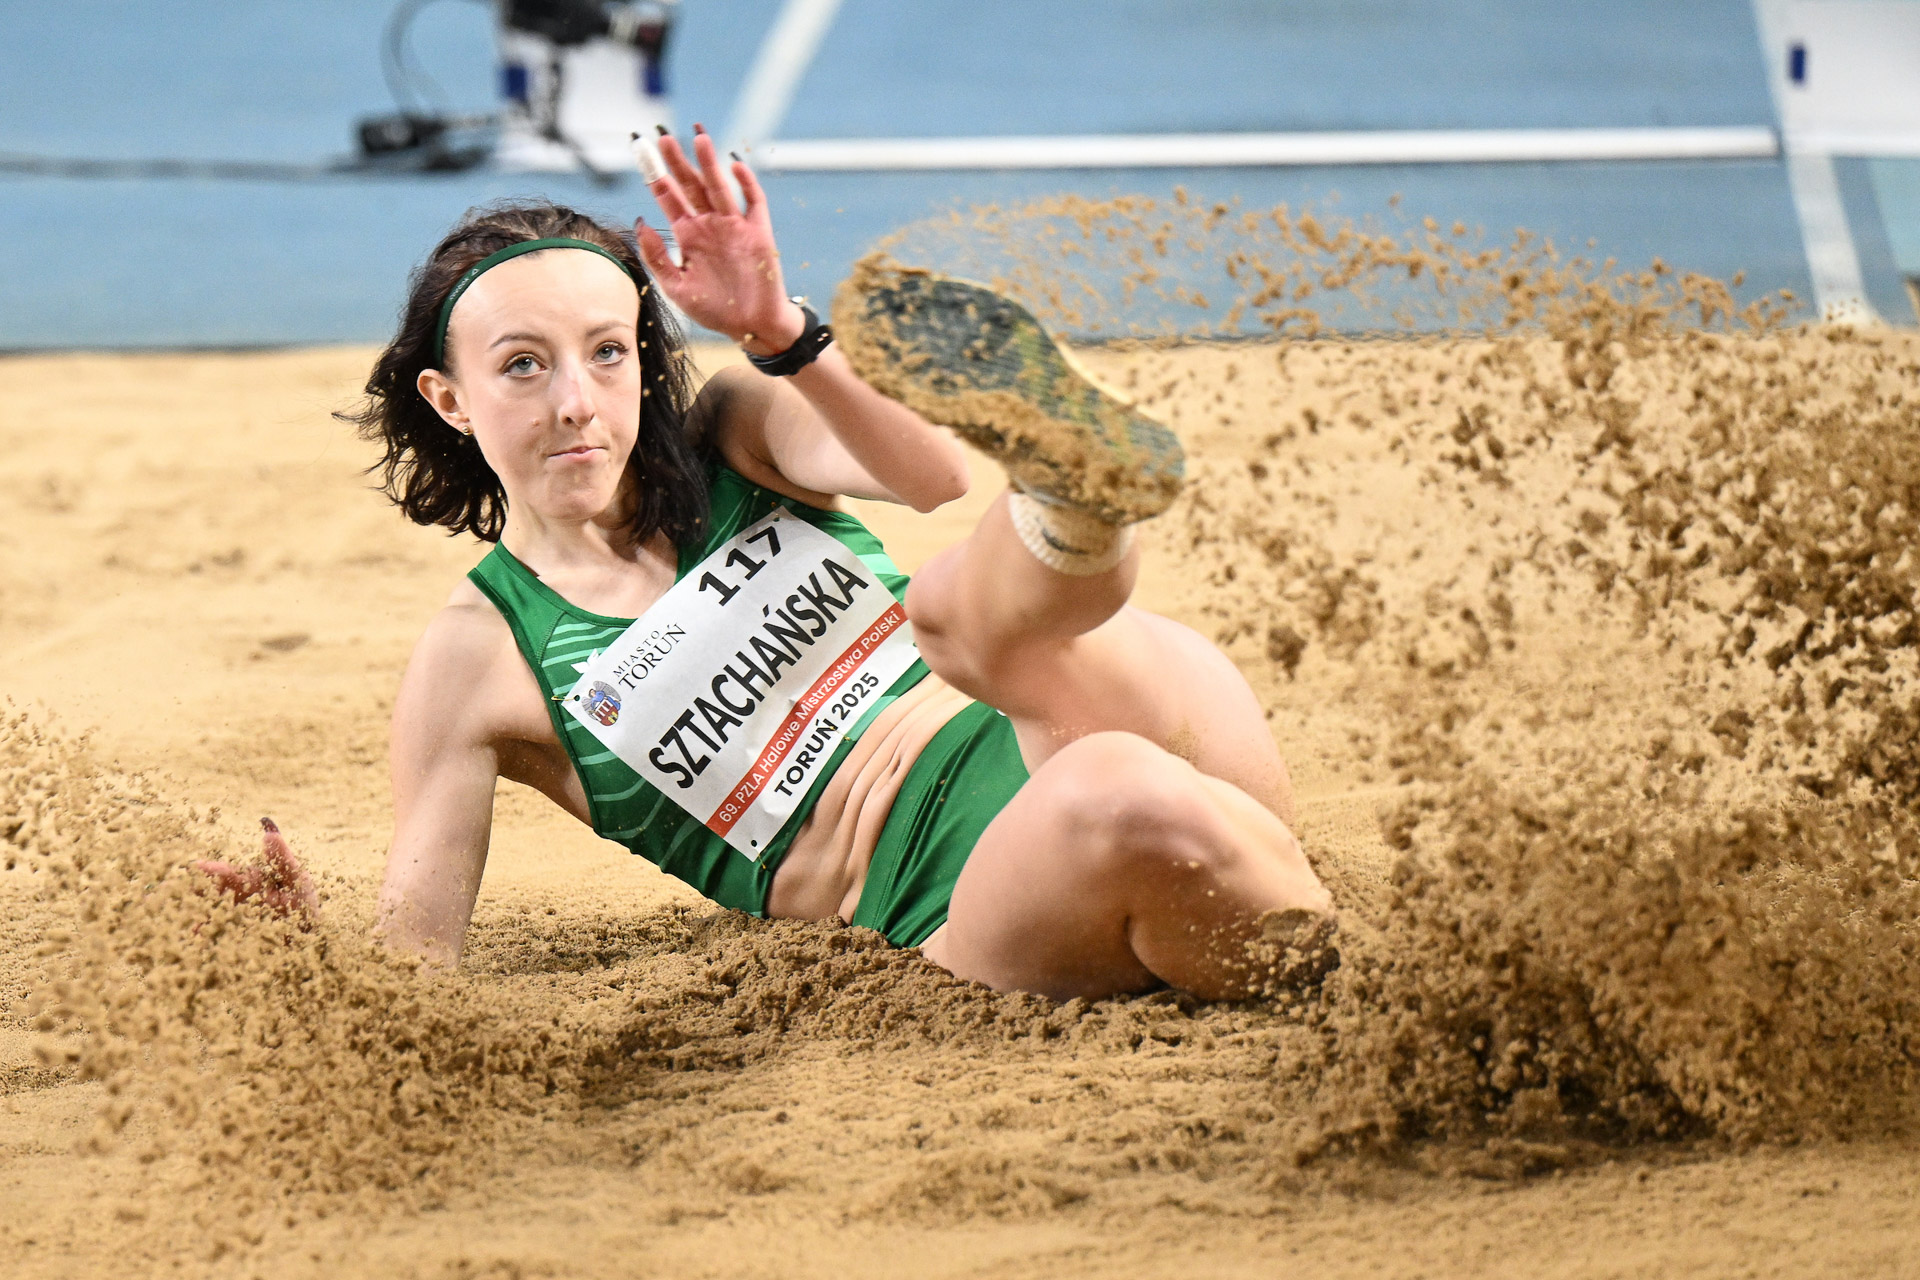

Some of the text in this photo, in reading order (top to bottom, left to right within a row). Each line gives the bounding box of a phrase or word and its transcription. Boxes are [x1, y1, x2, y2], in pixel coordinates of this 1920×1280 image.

[699, 526, 781, 606] 117
[613, 630, 660, 677] MIASTO
[618, 623, 686, 690] TORUŃ
[649, 558, 869, 788] SZTACHAŃSKA
[719, 610, 901, 822] 69. PZLA Halowe Mistrzostwa Polski
[774, 672, 880, 797] TORUŃ 2025
